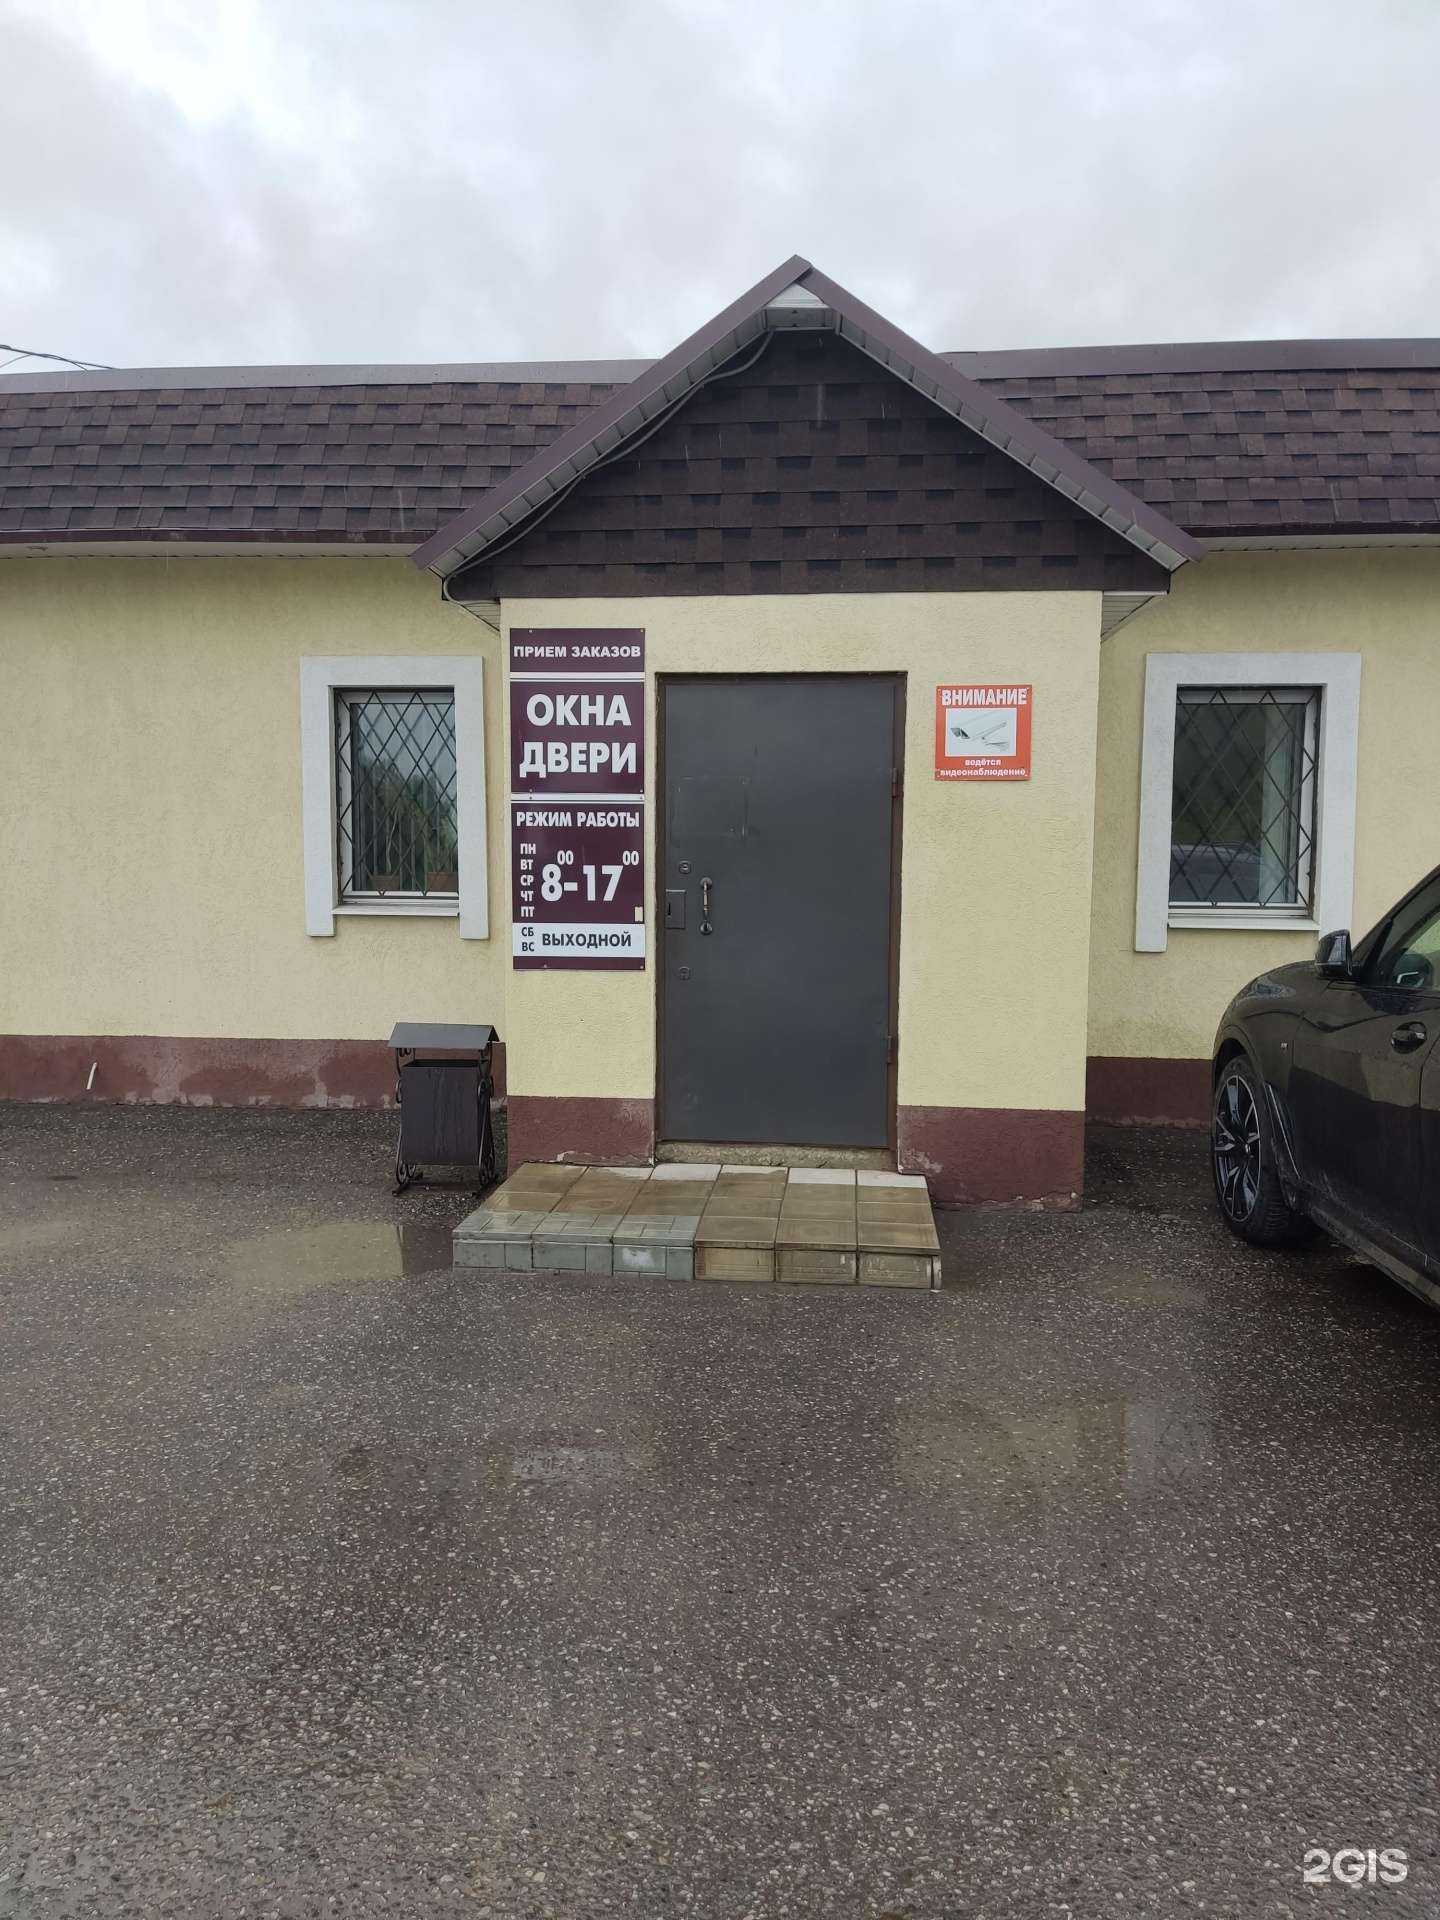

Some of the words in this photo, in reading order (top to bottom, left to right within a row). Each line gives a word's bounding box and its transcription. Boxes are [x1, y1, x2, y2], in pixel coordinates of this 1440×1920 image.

[513, 645, 567, 658] ПРИЕМ
[571, 645, 641, 658] ЗАКАЗОВ
[941, 688, 1028, 706] ВНИМАНИЕ
[526, 693, 632, 727] ОКНА
[519, 741, 637, 778] ДВЕРИ
[516, 811, 572, 827] РЕЖИМ
[576, 811, 640, 828] РАБОТЫ
[519, 843, 537, 855] ПН
[520, 859, 534, 871] ВТ
[520, 874, 534, 887] СР
[520, 890, 534, 902] ЧТ
[520, 906, 535, 918] ПТ
[521, 927, 534, 937] СБ
[541, 931, 632, 949] ВЫХОДНОЙ
[521, 942, 535, 952] ВС
